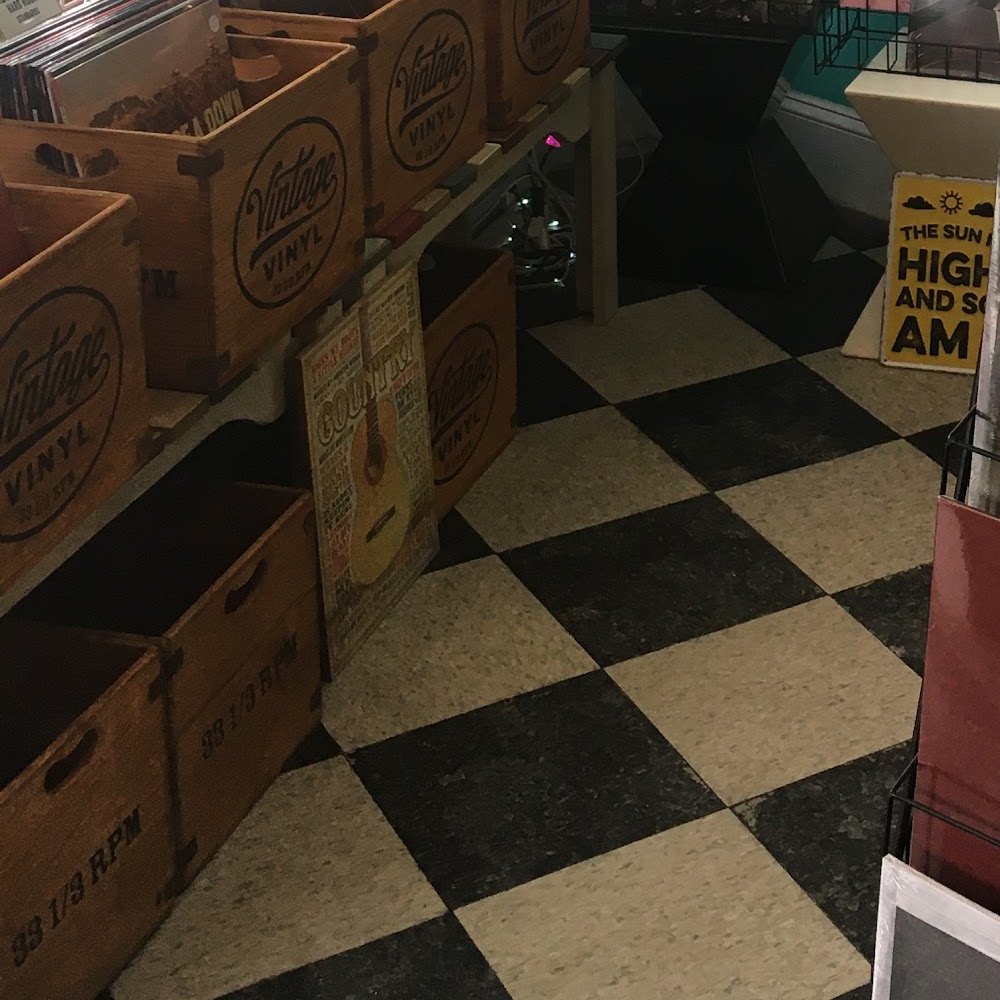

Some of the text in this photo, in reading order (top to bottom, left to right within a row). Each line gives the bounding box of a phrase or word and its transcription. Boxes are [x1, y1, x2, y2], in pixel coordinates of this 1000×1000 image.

[530, 17, 566, 57] VINYL
[396, 32, 467, 110] Vintage
[204, 88, 245, 132] DOWN
[408, 102, 456, 147] VINYL
[246, 143, 339, 240] Vintage
[263, 224, 323, 282] VINYL
[900, 224, 939, 242] THE
[943, 224, 981, 245] SUN
[898, 246, 990, 288] HIGH
[895, 286, 955, 312] AND
[891, 315, 970, 360] AM
[317, 320, 416, 446] COUNTRY
[438, 411, 480, 462] VINYL
[5, 420, 91, 506] VINYL
[201, 634, 298, 761] 33 1/3 RPM
[12, 804, 143, 968] 33 1/3 RPM
